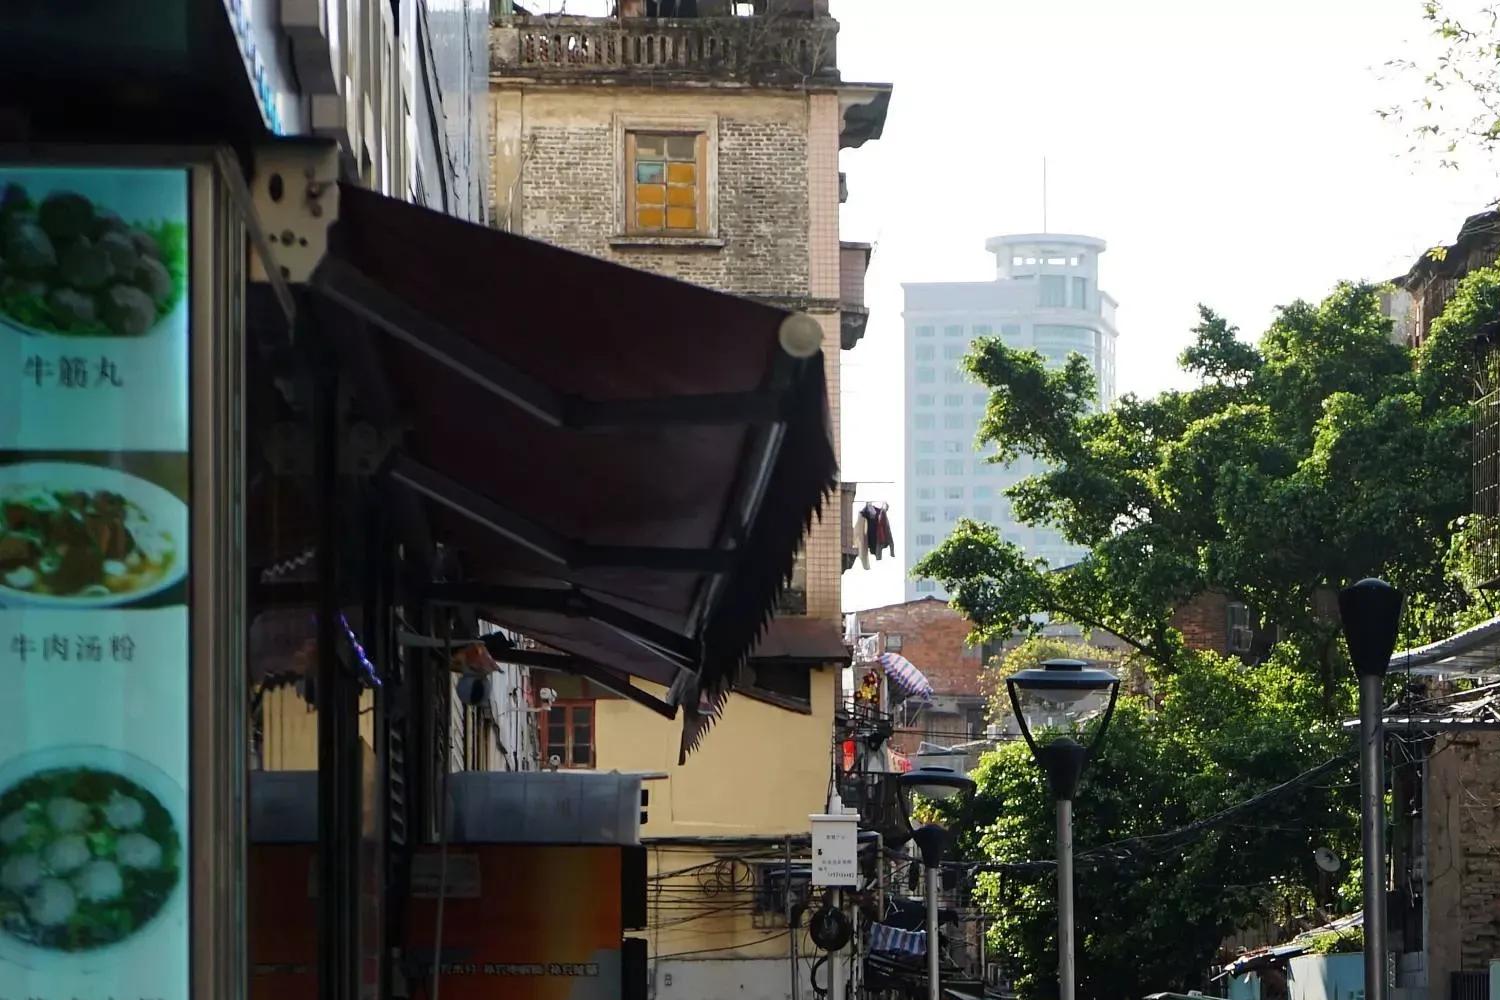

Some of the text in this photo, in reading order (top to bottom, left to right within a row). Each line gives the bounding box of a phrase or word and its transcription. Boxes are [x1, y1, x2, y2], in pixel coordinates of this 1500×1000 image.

[23, 354, 124, 388] 牛筋丸
[10, 634, 136, 662] 牛肉汤粉
